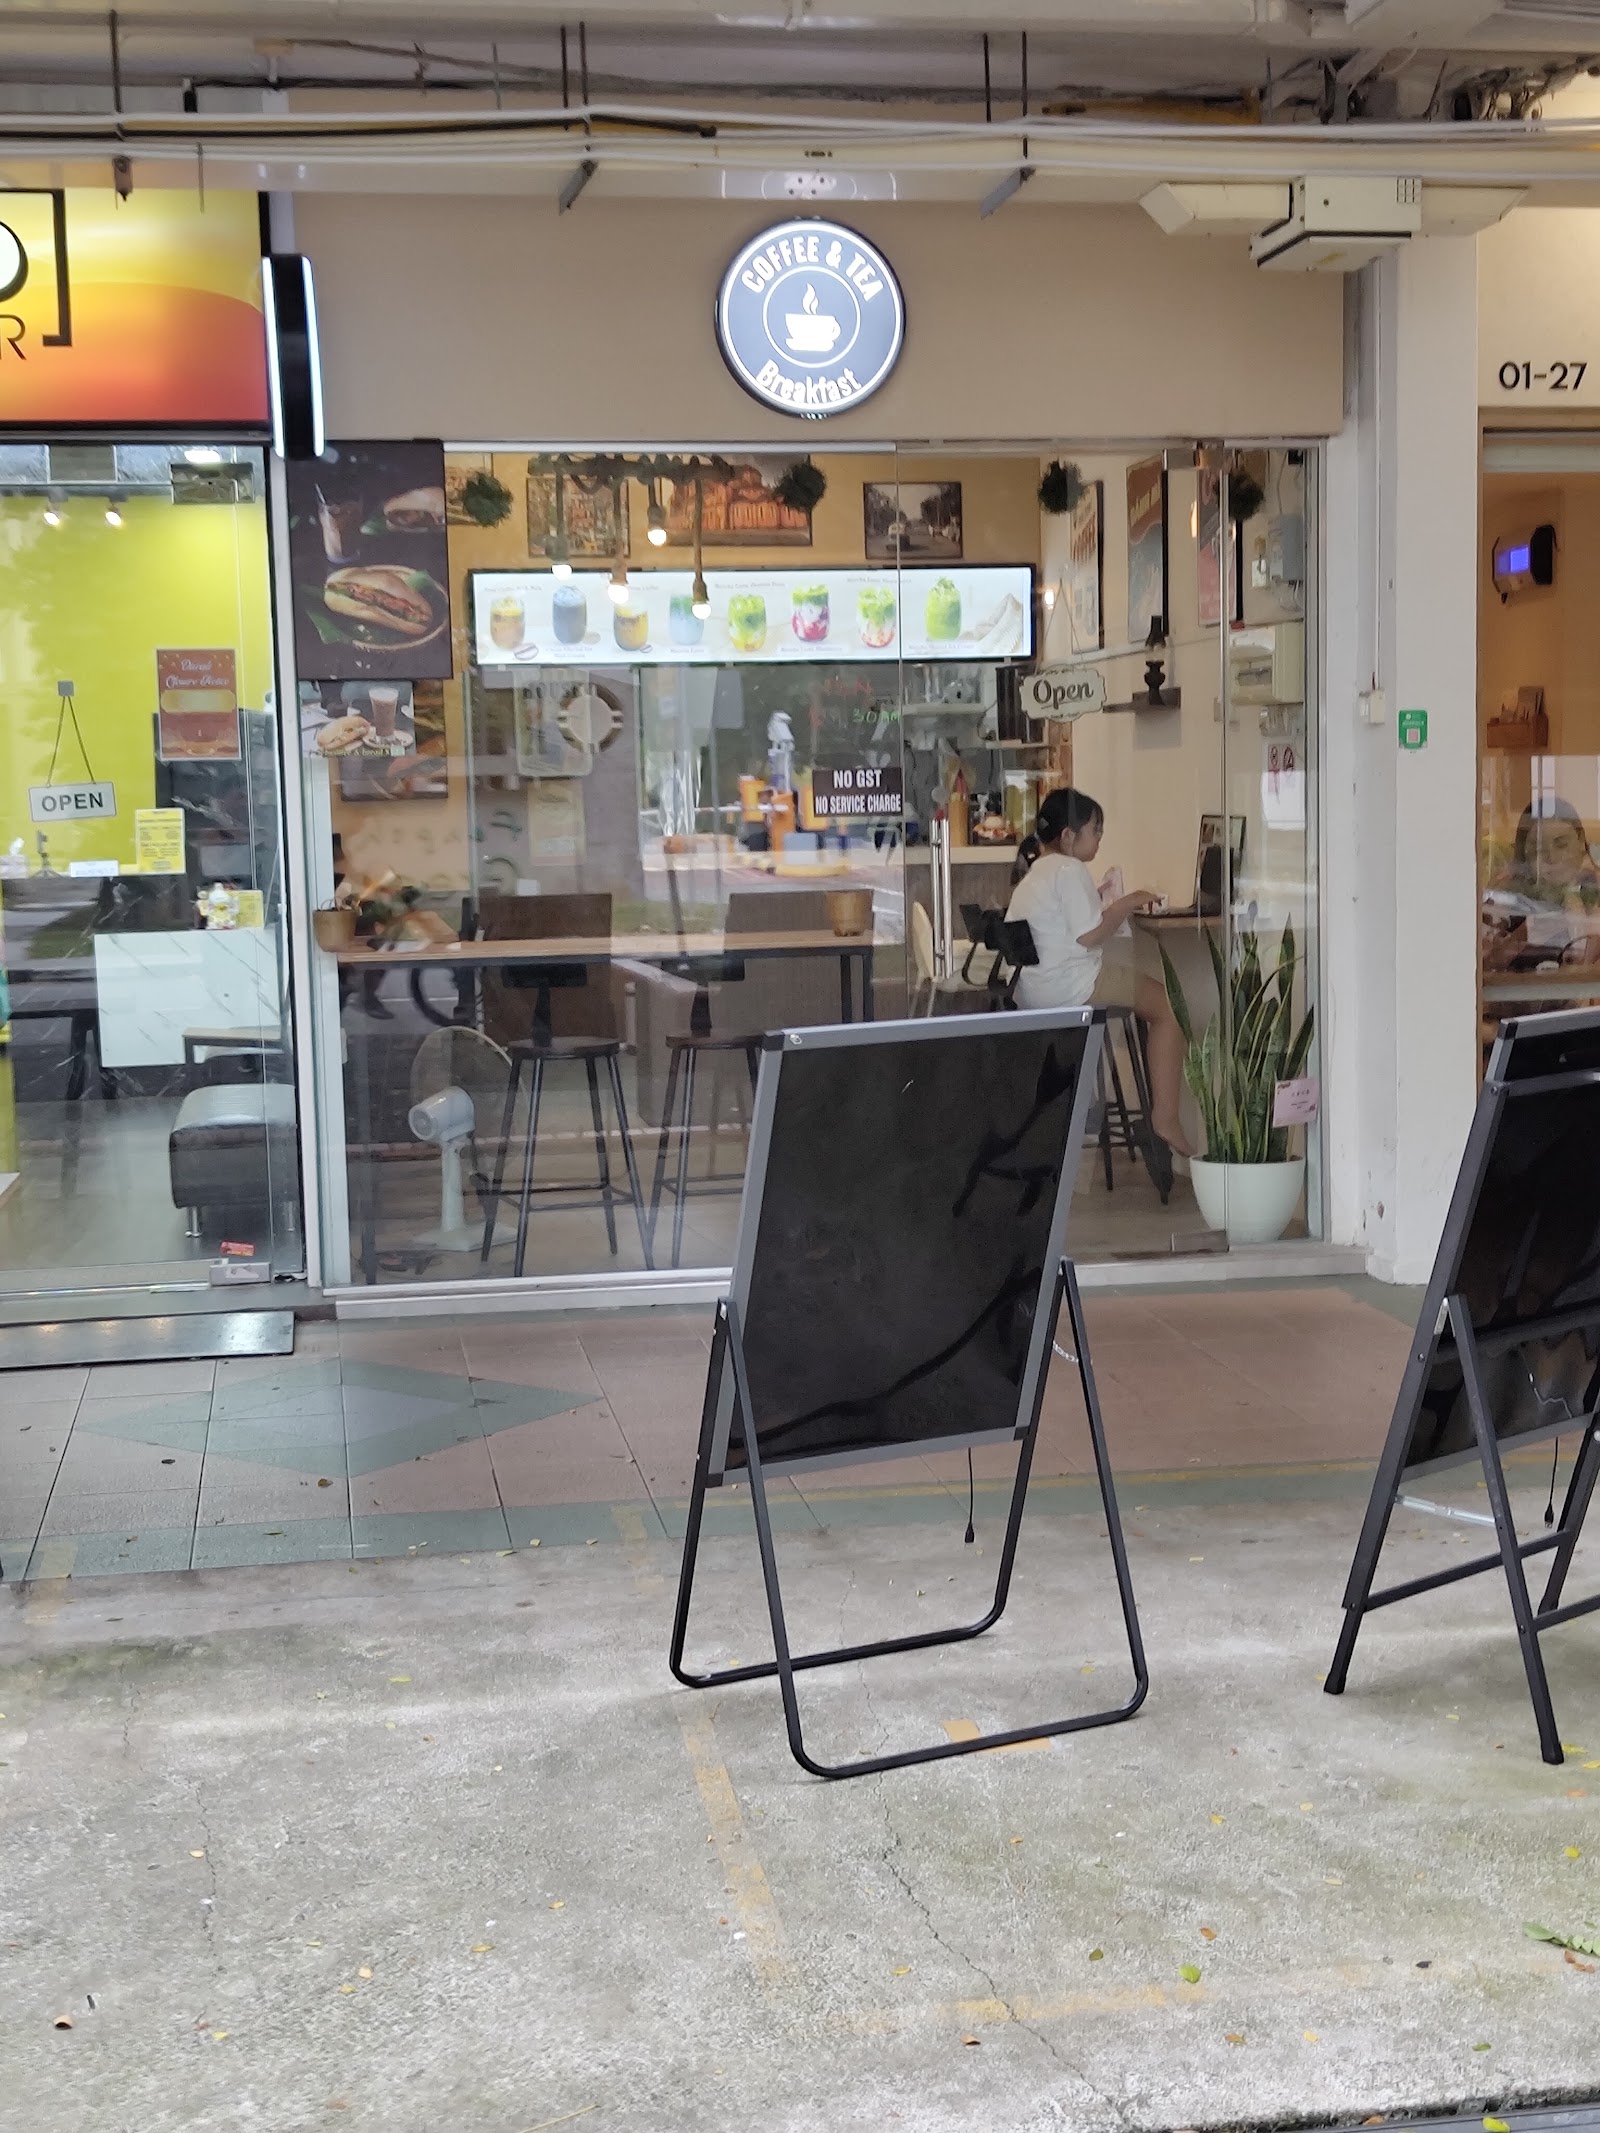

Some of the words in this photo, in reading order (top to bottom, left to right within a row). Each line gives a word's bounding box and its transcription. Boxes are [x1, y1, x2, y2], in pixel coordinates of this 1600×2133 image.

[741, 236, 820, 294] COFFEE
[825, 240, 843, 270] &
[845, 252, 884, 302] TEA
[756, 359, 862, 405] Breakfast
[1498, 360, 1587, 390] 01-27
[1033, 680, 1094, 710] Open
[833, 769, 853, 789] NO
[856, 769, 882, 788] GST
[41, 791, 104, 812] OPEN
[815, 796, 829, 814] NO
[830, 794, 866, 814] SERVICE
[867, 794, 901, 813] CHARGE
